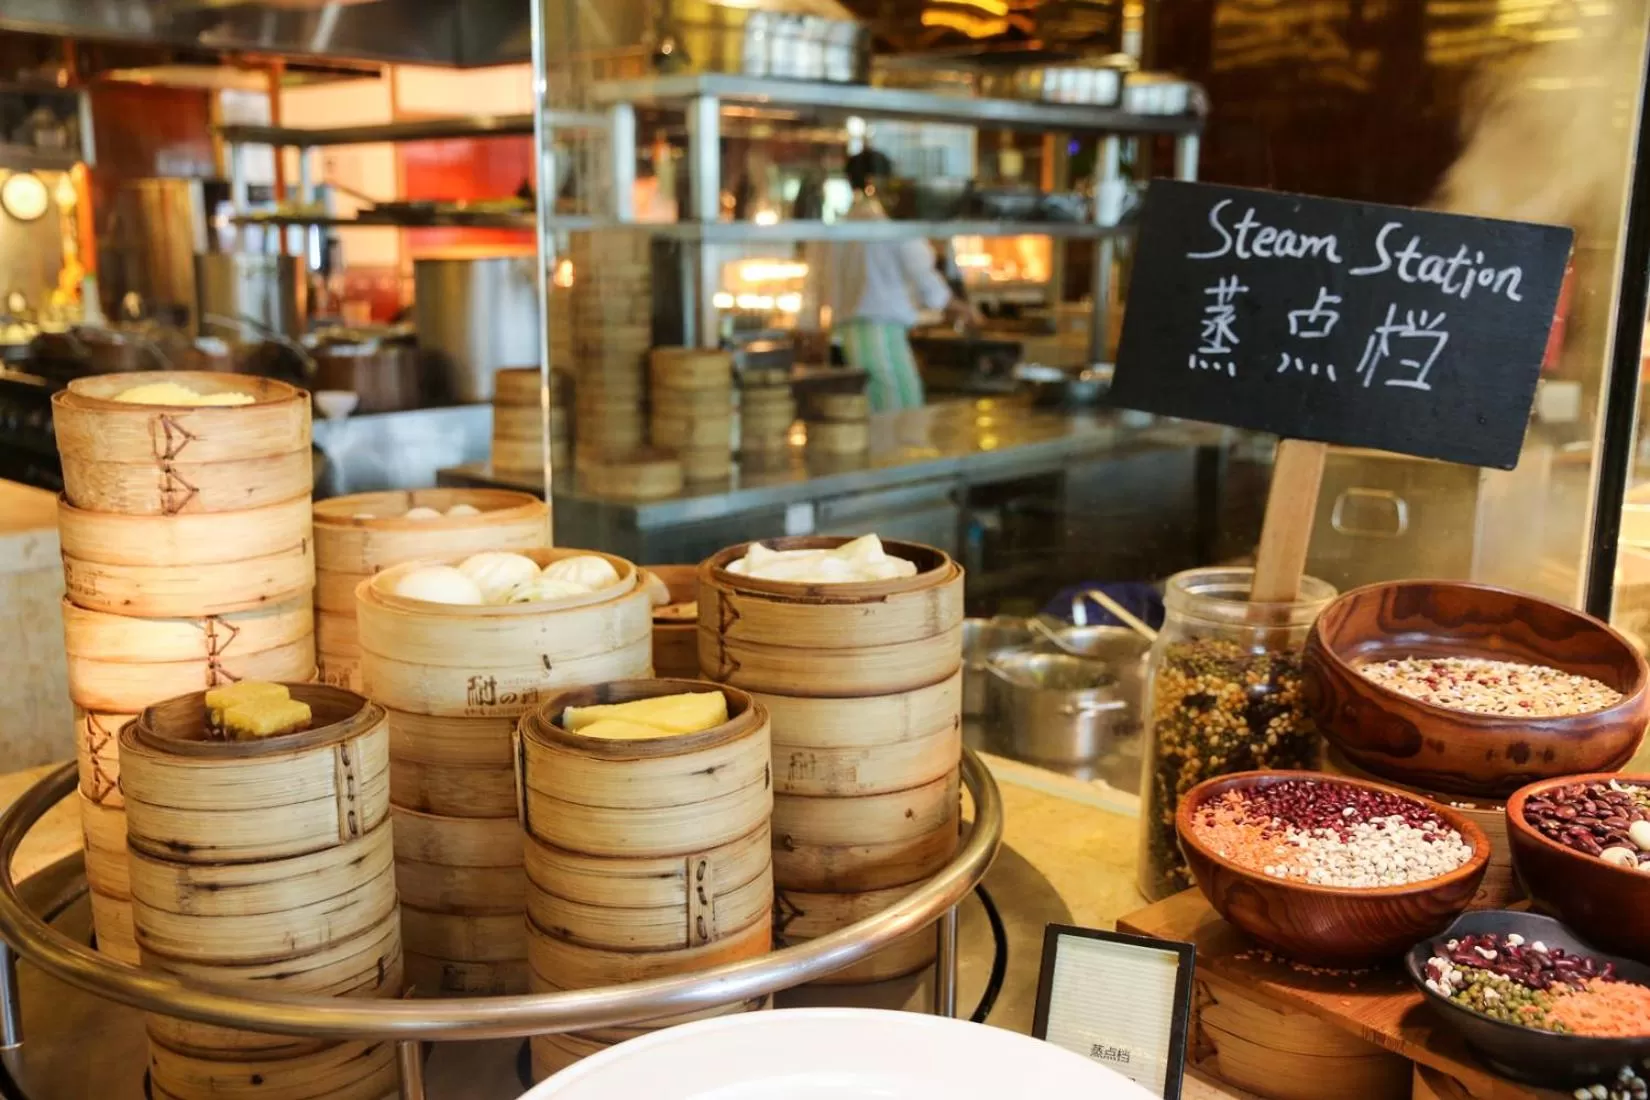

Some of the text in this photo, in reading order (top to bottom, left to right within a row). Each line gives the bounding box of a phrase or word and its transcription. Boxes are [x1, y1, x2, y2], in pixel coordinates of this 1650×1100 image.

[1187, 199, 1523, 302] Steam Station
[1188, 275, 1449, 391] 蒸点档
[1090, 1043, 1130, 1063] 蒸点档
